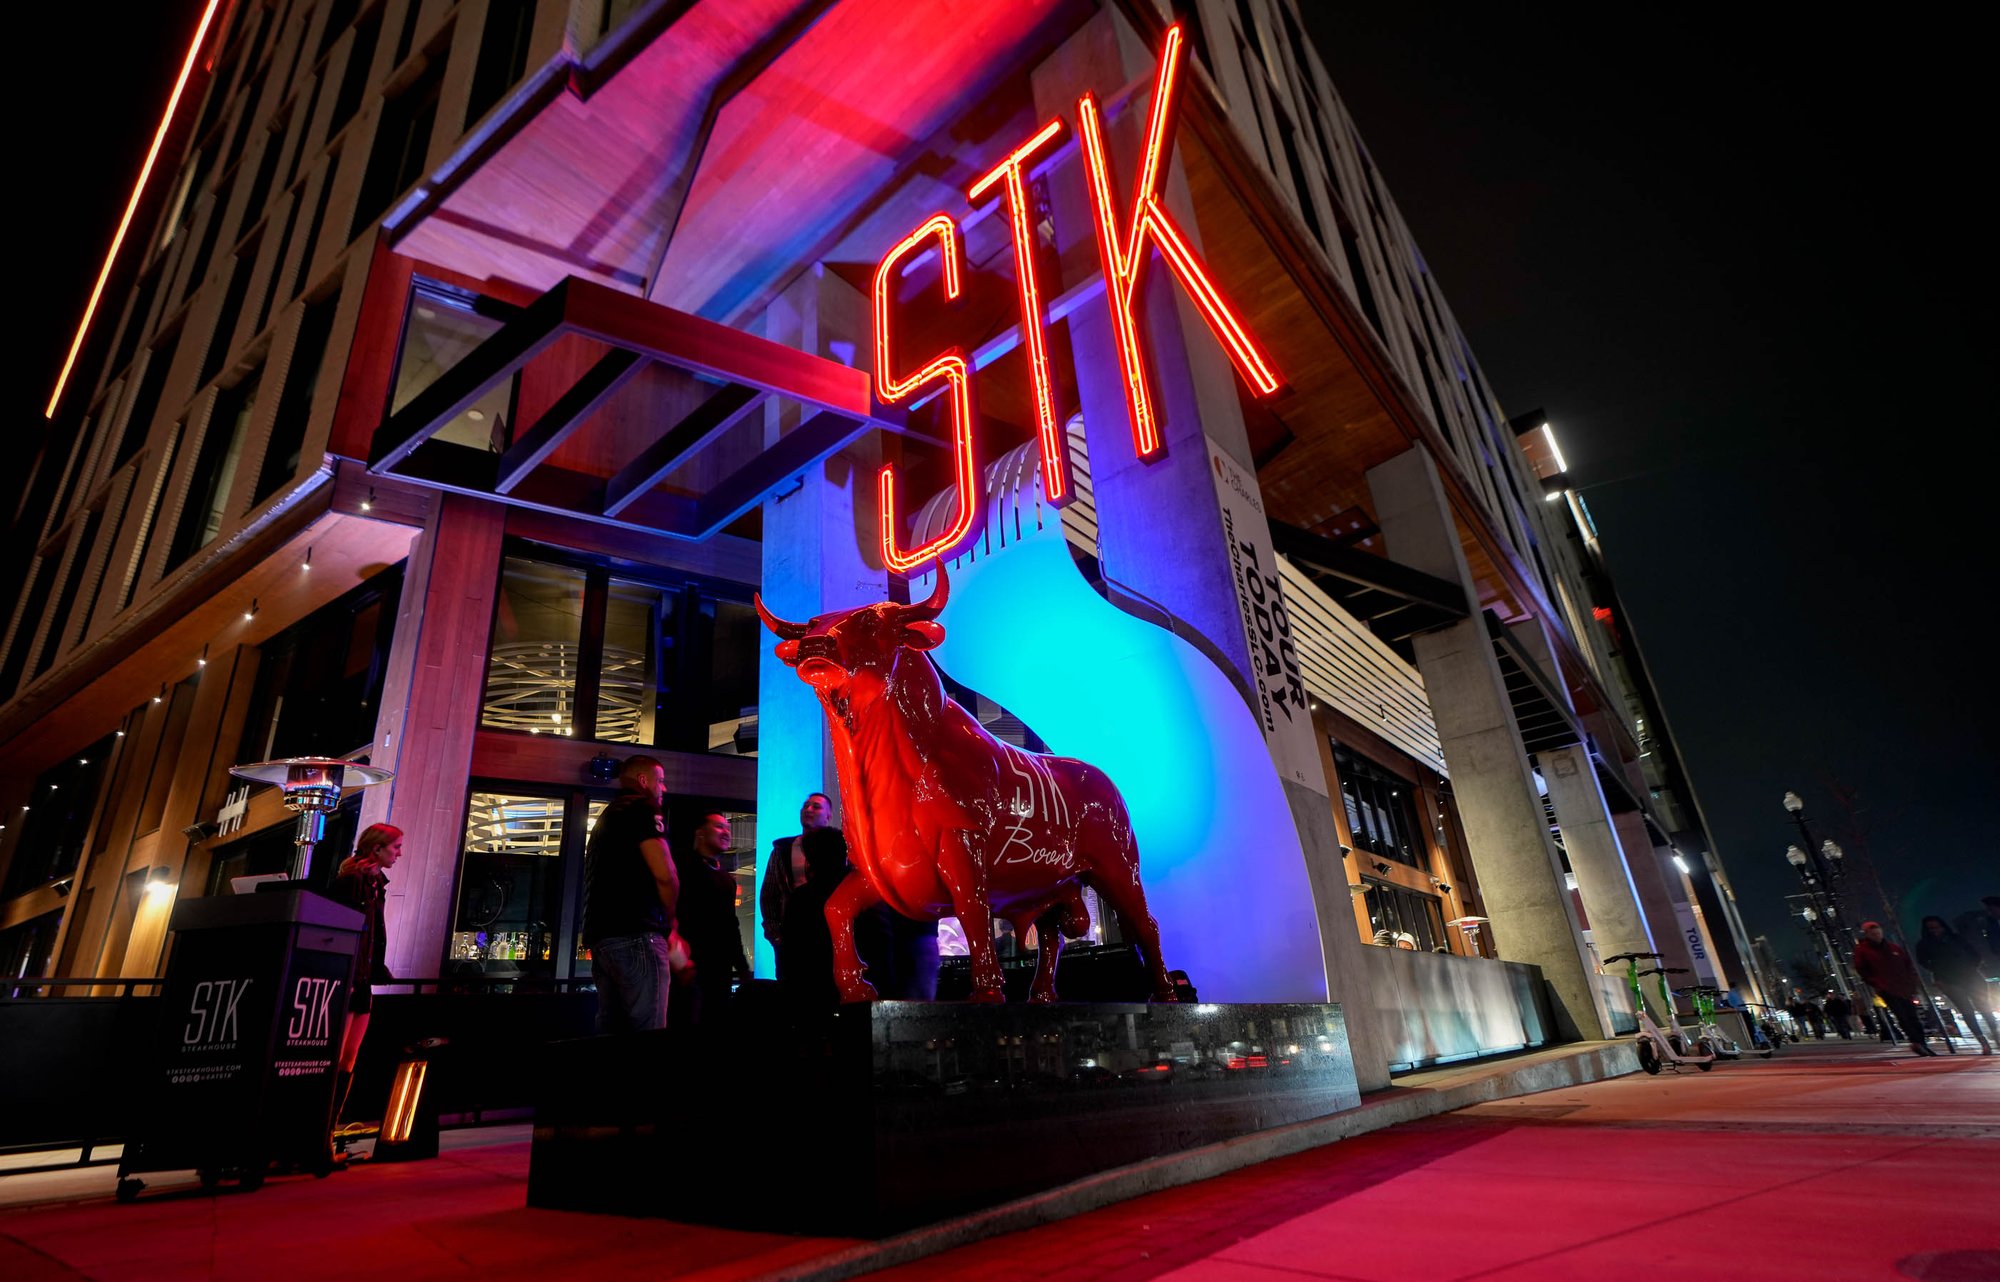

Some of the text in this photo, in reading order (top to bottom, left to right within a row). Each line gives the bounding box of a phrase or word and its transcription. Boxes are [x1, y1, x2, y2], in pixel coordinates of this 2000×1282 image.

[872, 22, 1288, 574] STK
[1240, 541, 1293, 724] TODAY
[1265, 574, 1306, 710] TOUR
[1003, 745, 1071, 829] STK
[1685, 927, 1705, 960] TOUR
[181, 1042, 237, 1053] STEAKHOUSE
[286, 1039, 328, 1047] STEAKHOUSE
